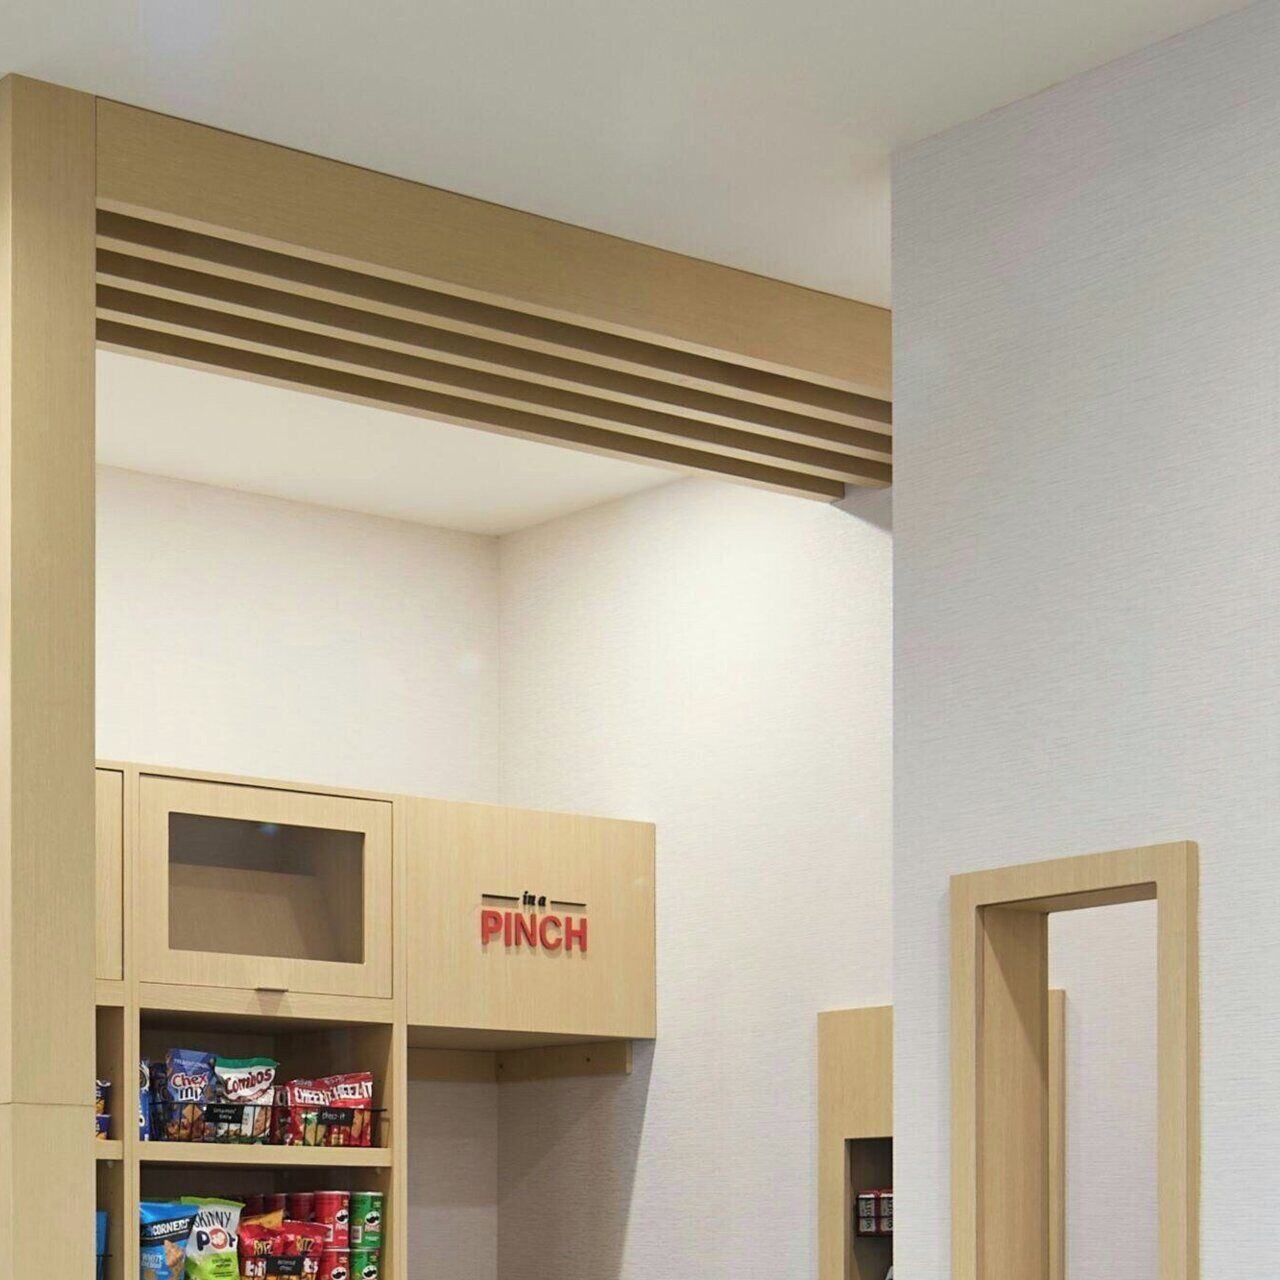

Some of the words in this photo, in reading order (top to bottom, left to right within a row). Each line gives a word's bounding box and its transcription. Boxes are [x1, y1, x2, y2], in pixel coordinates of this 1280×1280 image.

[523, 891, 536, 906] in
[538, 896, 546, 907] a
[481, 910, 588, 952] PINCH
[171, 1072, 208, 1088] Chex
